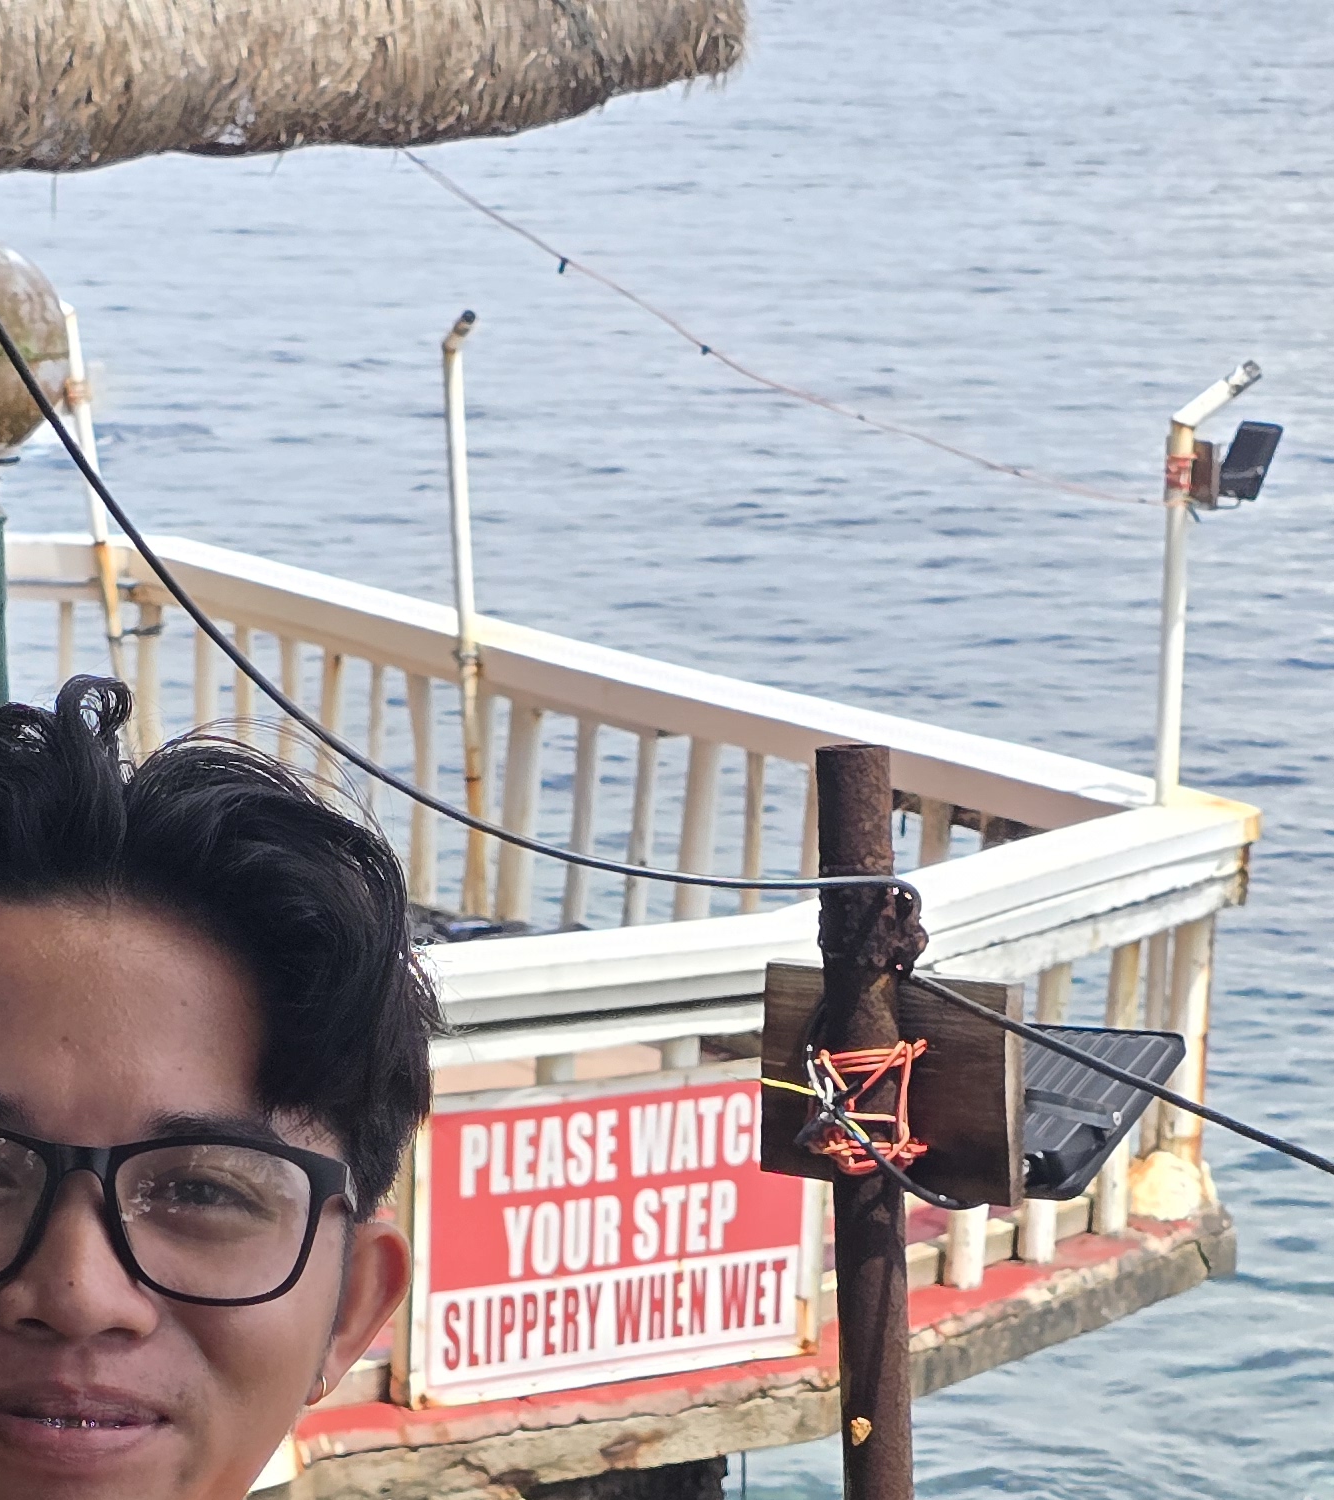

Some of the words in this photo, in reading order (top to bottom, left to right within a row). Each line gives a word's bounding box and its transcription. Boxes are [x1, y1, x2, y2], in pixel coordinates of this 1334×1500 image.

[459, 1110, 618, 1198] PLEASE
[629, 1091, 762, 1178] WATC
[503, 1194, 622, 1279] YOUR
[632, 1179, 738, 1262] STEP
[442, 1283, 603, 1371] SLIPPERY
[614, 1267, 707, 1346] WHEN
[720, 1260, 787, 1331] WET
